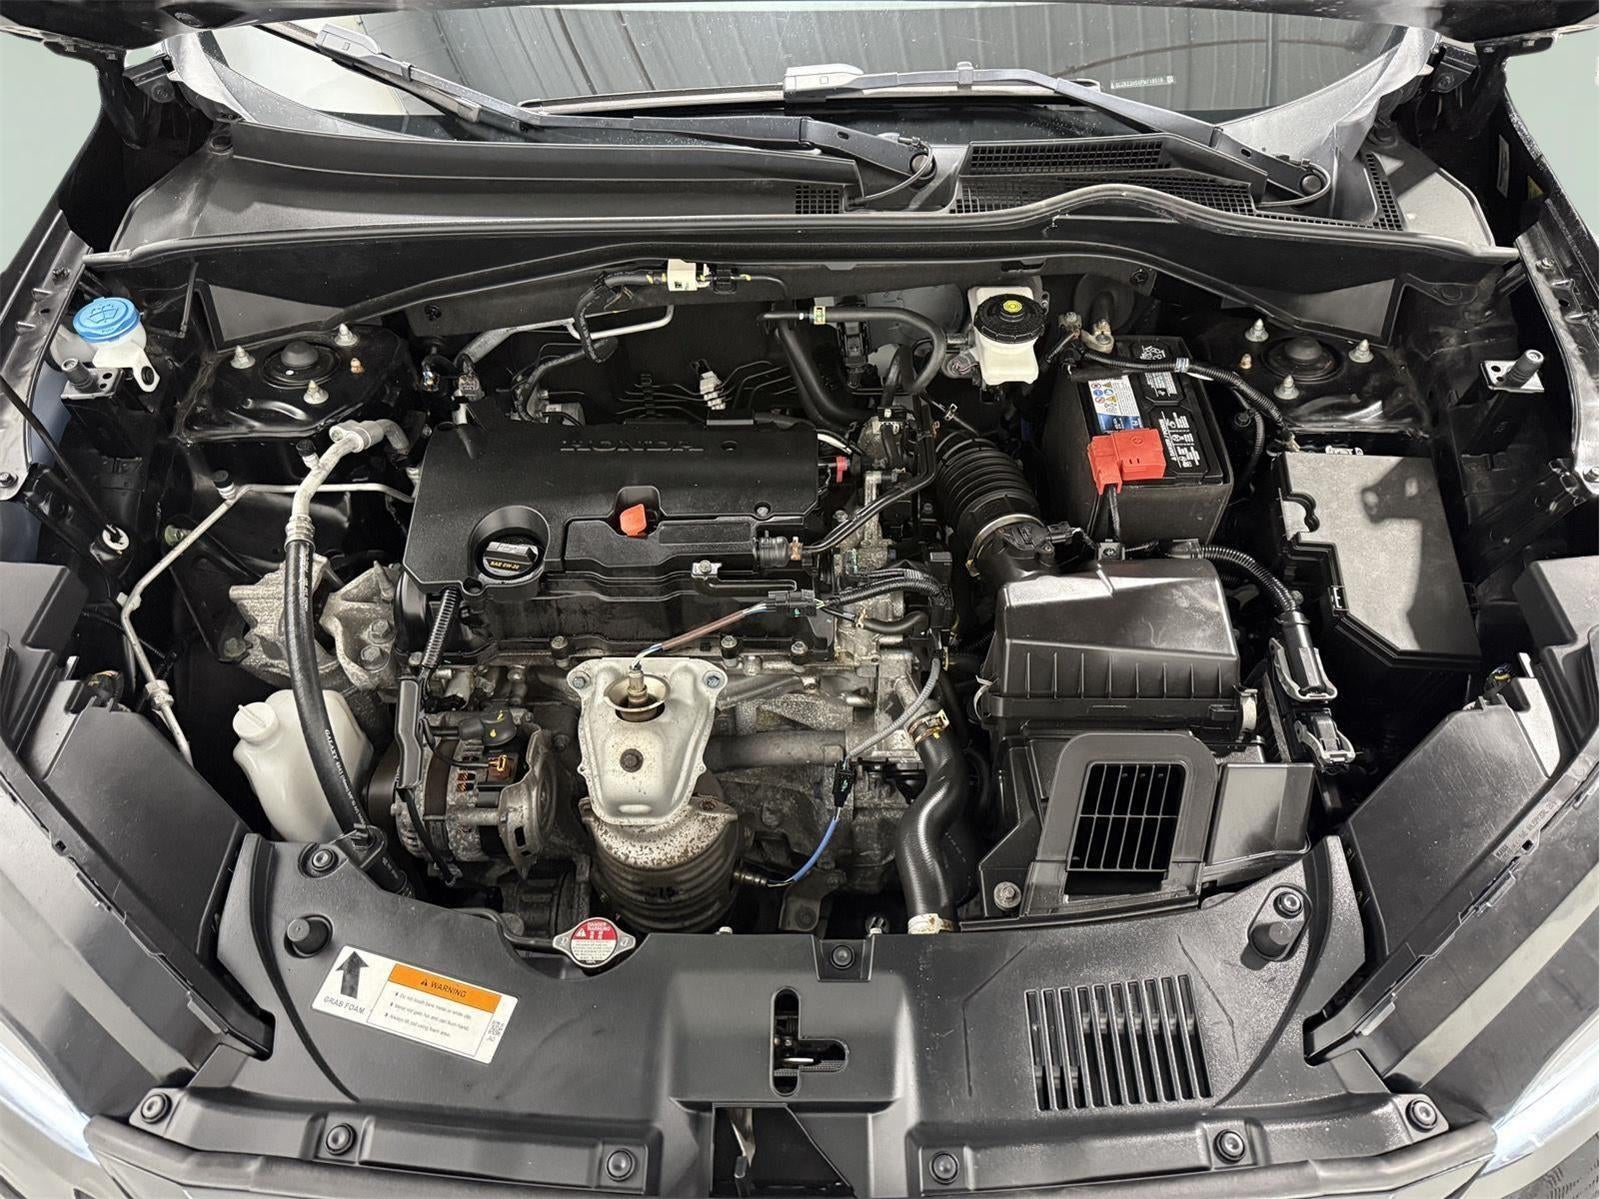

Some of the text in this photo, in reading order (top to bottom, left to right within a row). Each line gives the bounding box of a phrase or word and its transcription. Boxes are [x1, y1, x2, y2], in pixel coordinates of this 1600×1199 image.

[560, 440, 704, 452] HONDA
[431, 982, 466, 998] WARNING
[344, 1002, 366, 1014] FOAM
